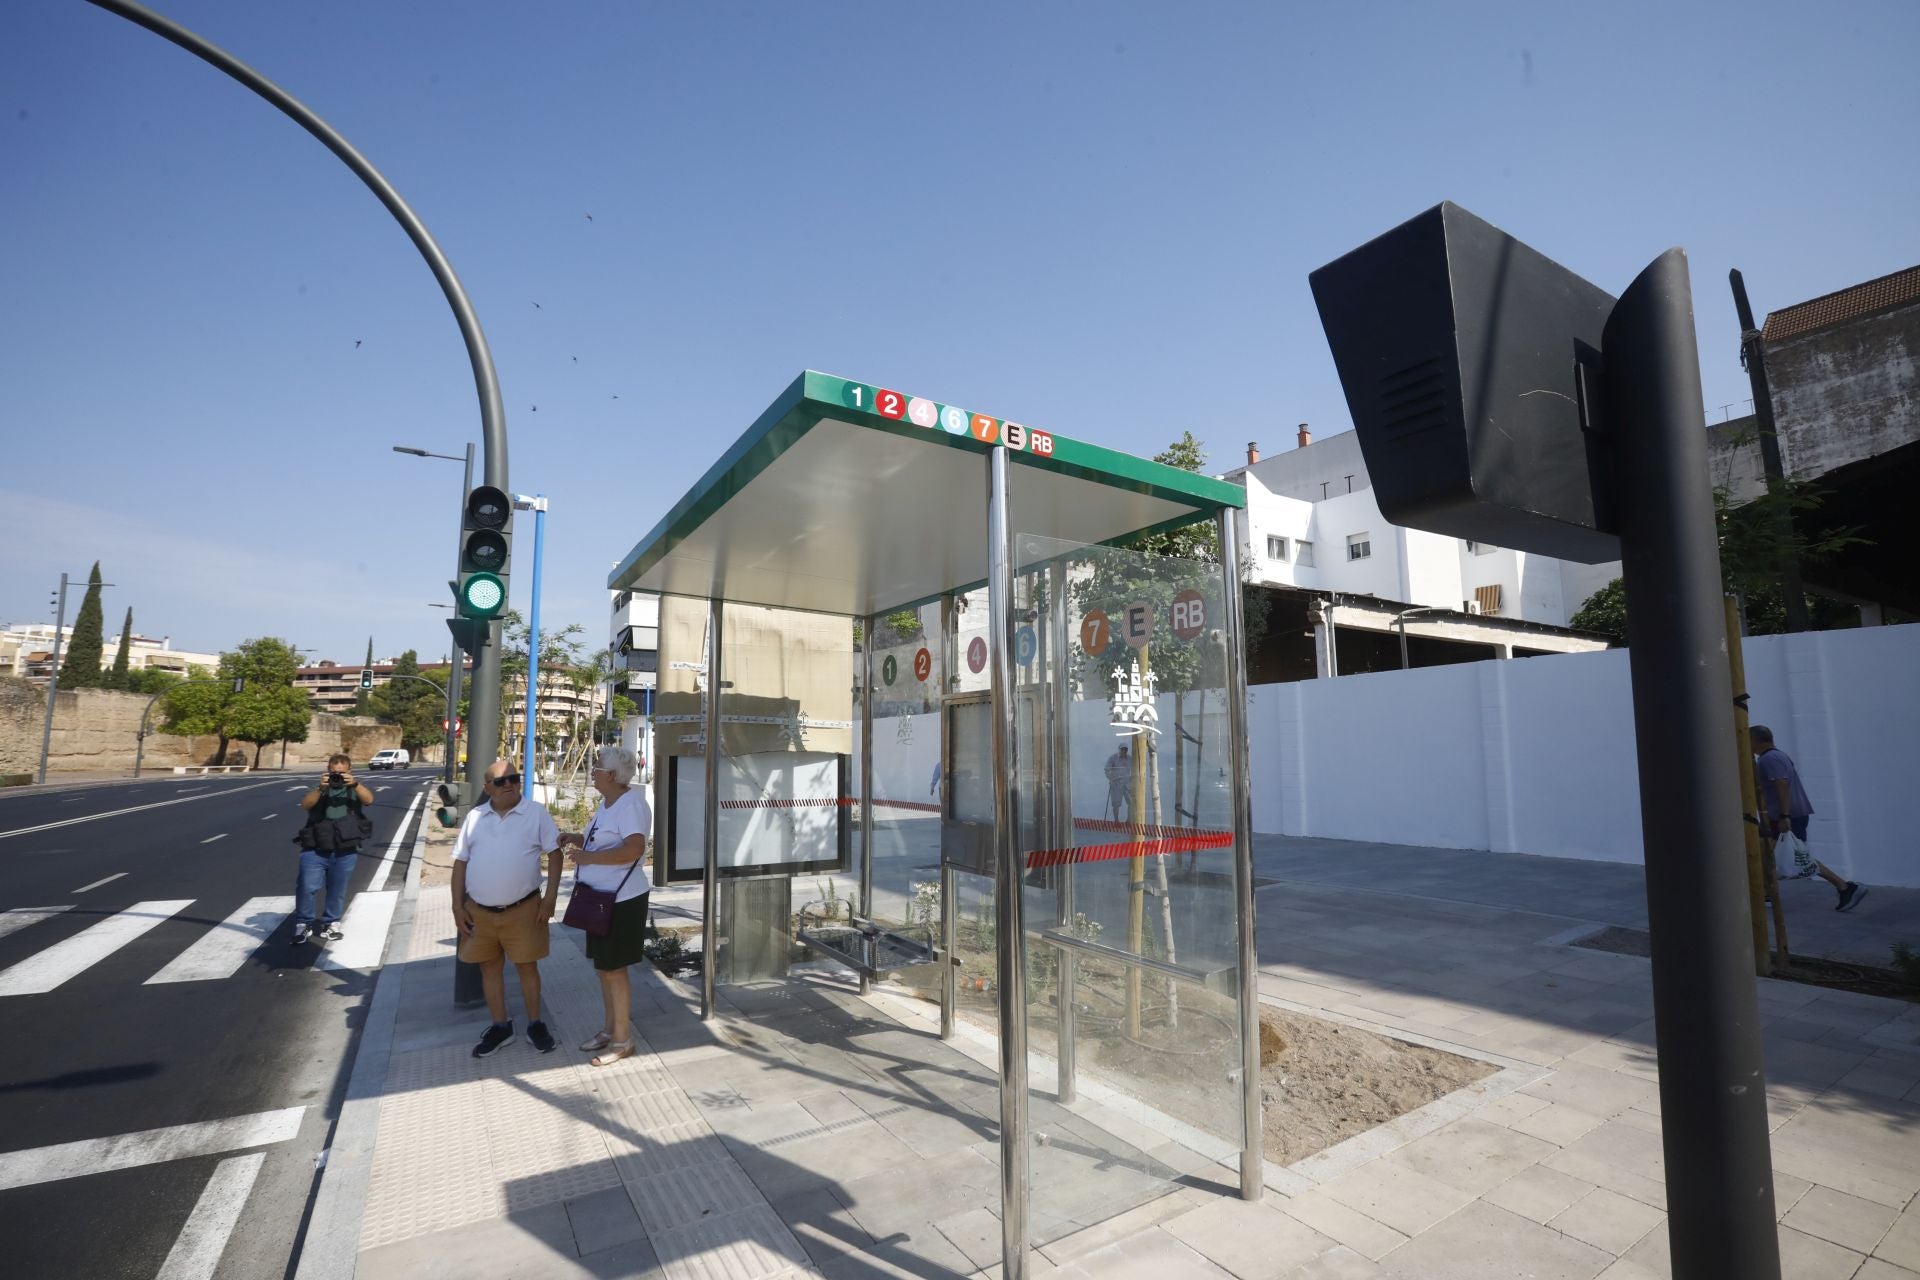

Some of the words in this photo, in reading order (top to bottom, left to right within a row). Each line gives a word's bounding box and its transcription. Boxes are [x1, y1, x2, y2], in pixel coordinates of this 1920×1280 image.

[851, 386, 862, 407] 1
[883, 394, 898, 415] 2
[915, 402, 929, 421] 4
[947, 410, 961, 429] 6
[978, 418, 992, 438] 7
[1007, 425, 1020, 446] E
[1031, 432, 1053, 454] RB
[886, 661, 892, 680] 1
[918, 654, 927, 674] 2
[971, 643, 981, 666] 4
[1020, 633, 1030, 657] 6
[1088, 619, 1101, 647] 7
[1129, 606, 1146, 638] E
[1173, 599, 1204, 630] RB
